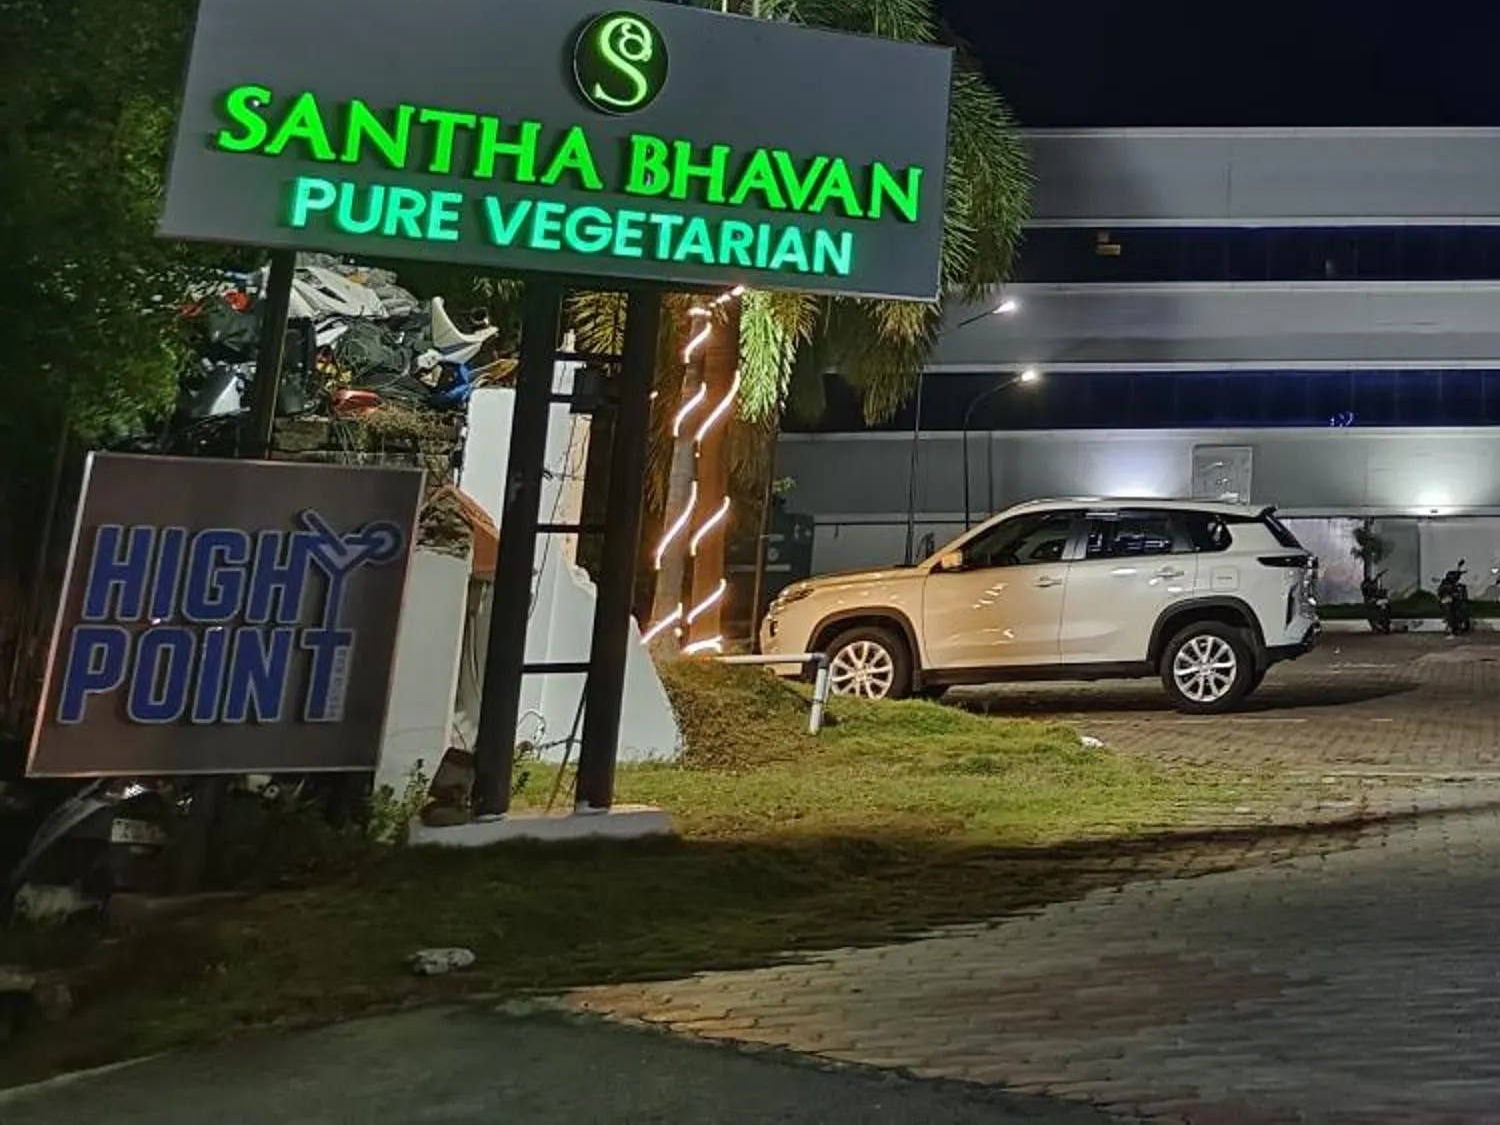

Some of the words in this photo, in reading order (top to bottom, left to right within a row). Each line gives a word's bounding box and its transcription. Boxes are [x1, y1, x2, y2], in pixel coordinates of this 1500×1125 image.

[216, 85, 603, 192] SANTHA
[626, 132, 924, 223] BHAVAN
[289, 178, 464, 242] PURE
[483, 197, 854, 276] VEGETARIAN
[56, 624, 357, 725] POINT
